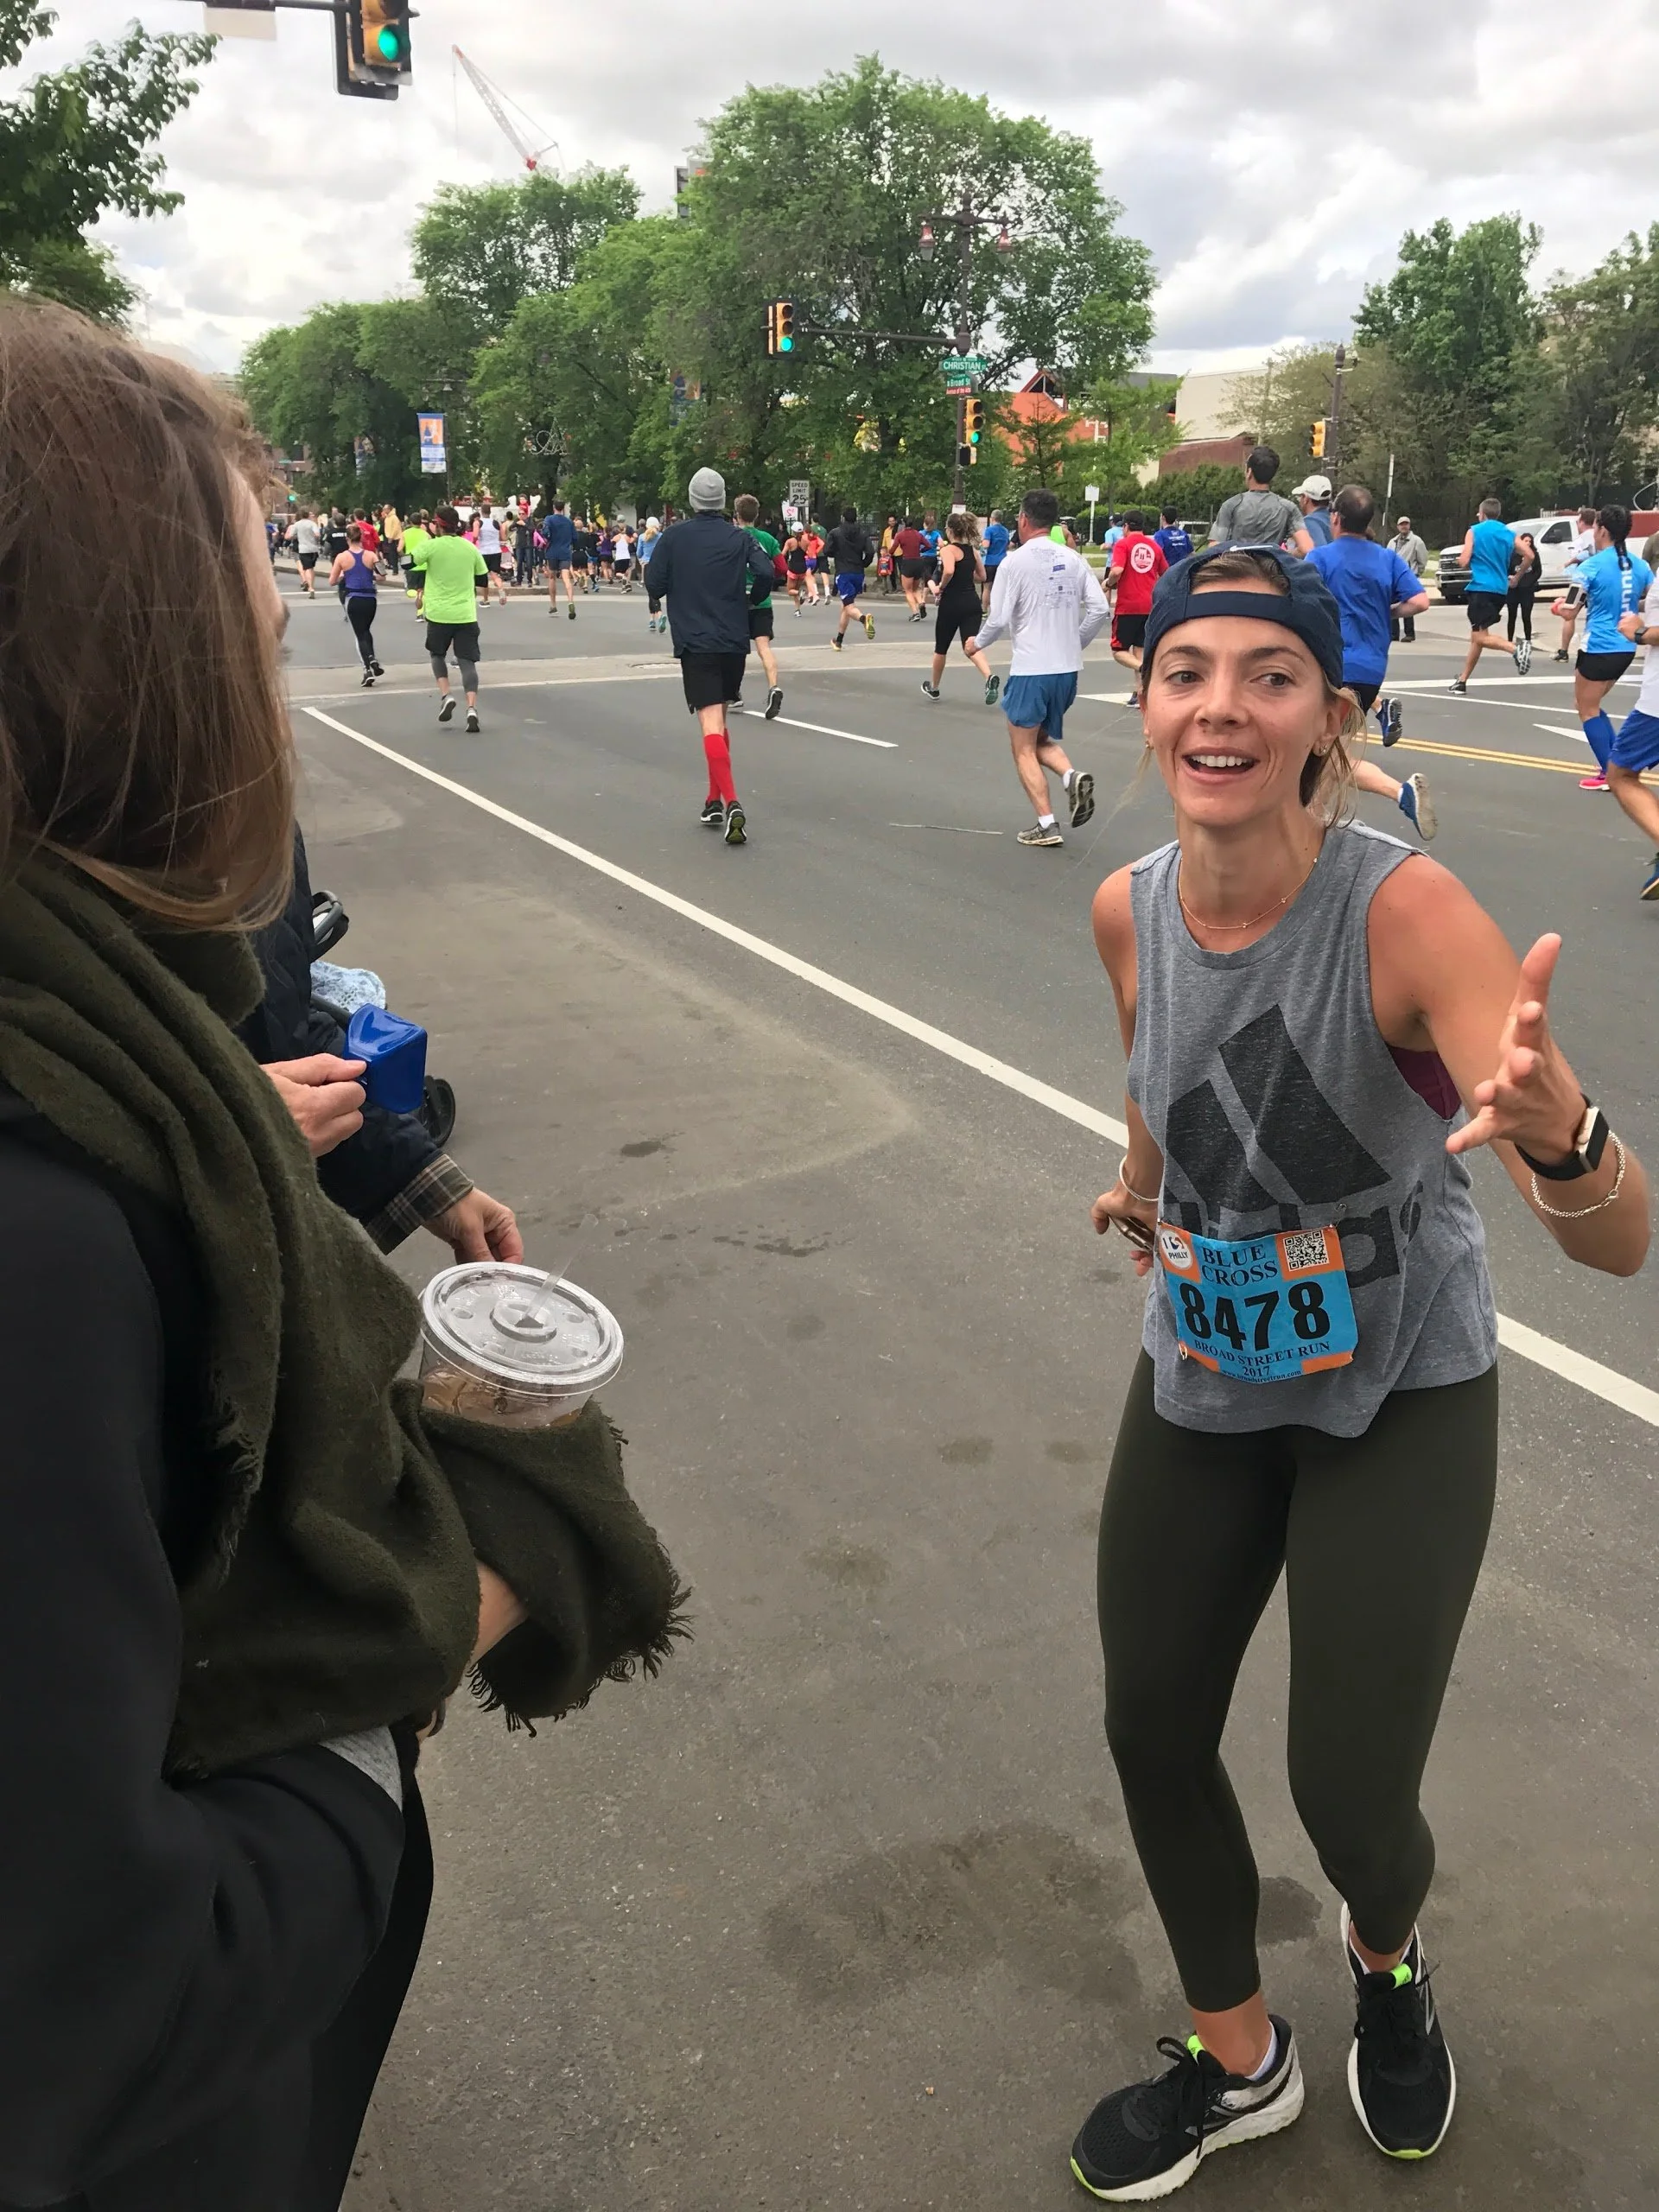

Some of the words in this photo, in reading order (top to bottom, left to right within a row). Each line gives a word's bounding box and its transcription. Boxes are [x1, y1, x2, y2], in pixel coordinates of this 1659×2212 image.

[943, 361, 981, 370] CHRISTIAN
[950, 378, 964, 387] Broad
[792, 494, 807, 504] 25
[1162, 1237, 1169, 1249] I
[1168, 1251, 1189, 1260] PHILLY
[1202, 1244, 1266, 1267] BLUE
[1202, 1260, 1278, 1286] CROSS
[1179, 1281, 1331, 1351] 8478
[1194, 1339, 1236, 1362] BROAD
[1237, 1348, 1294, 1366] STREET
[1298, 1340, 1331, 1357] RUN
[1243, 1365, 1271, 1377] 2017
